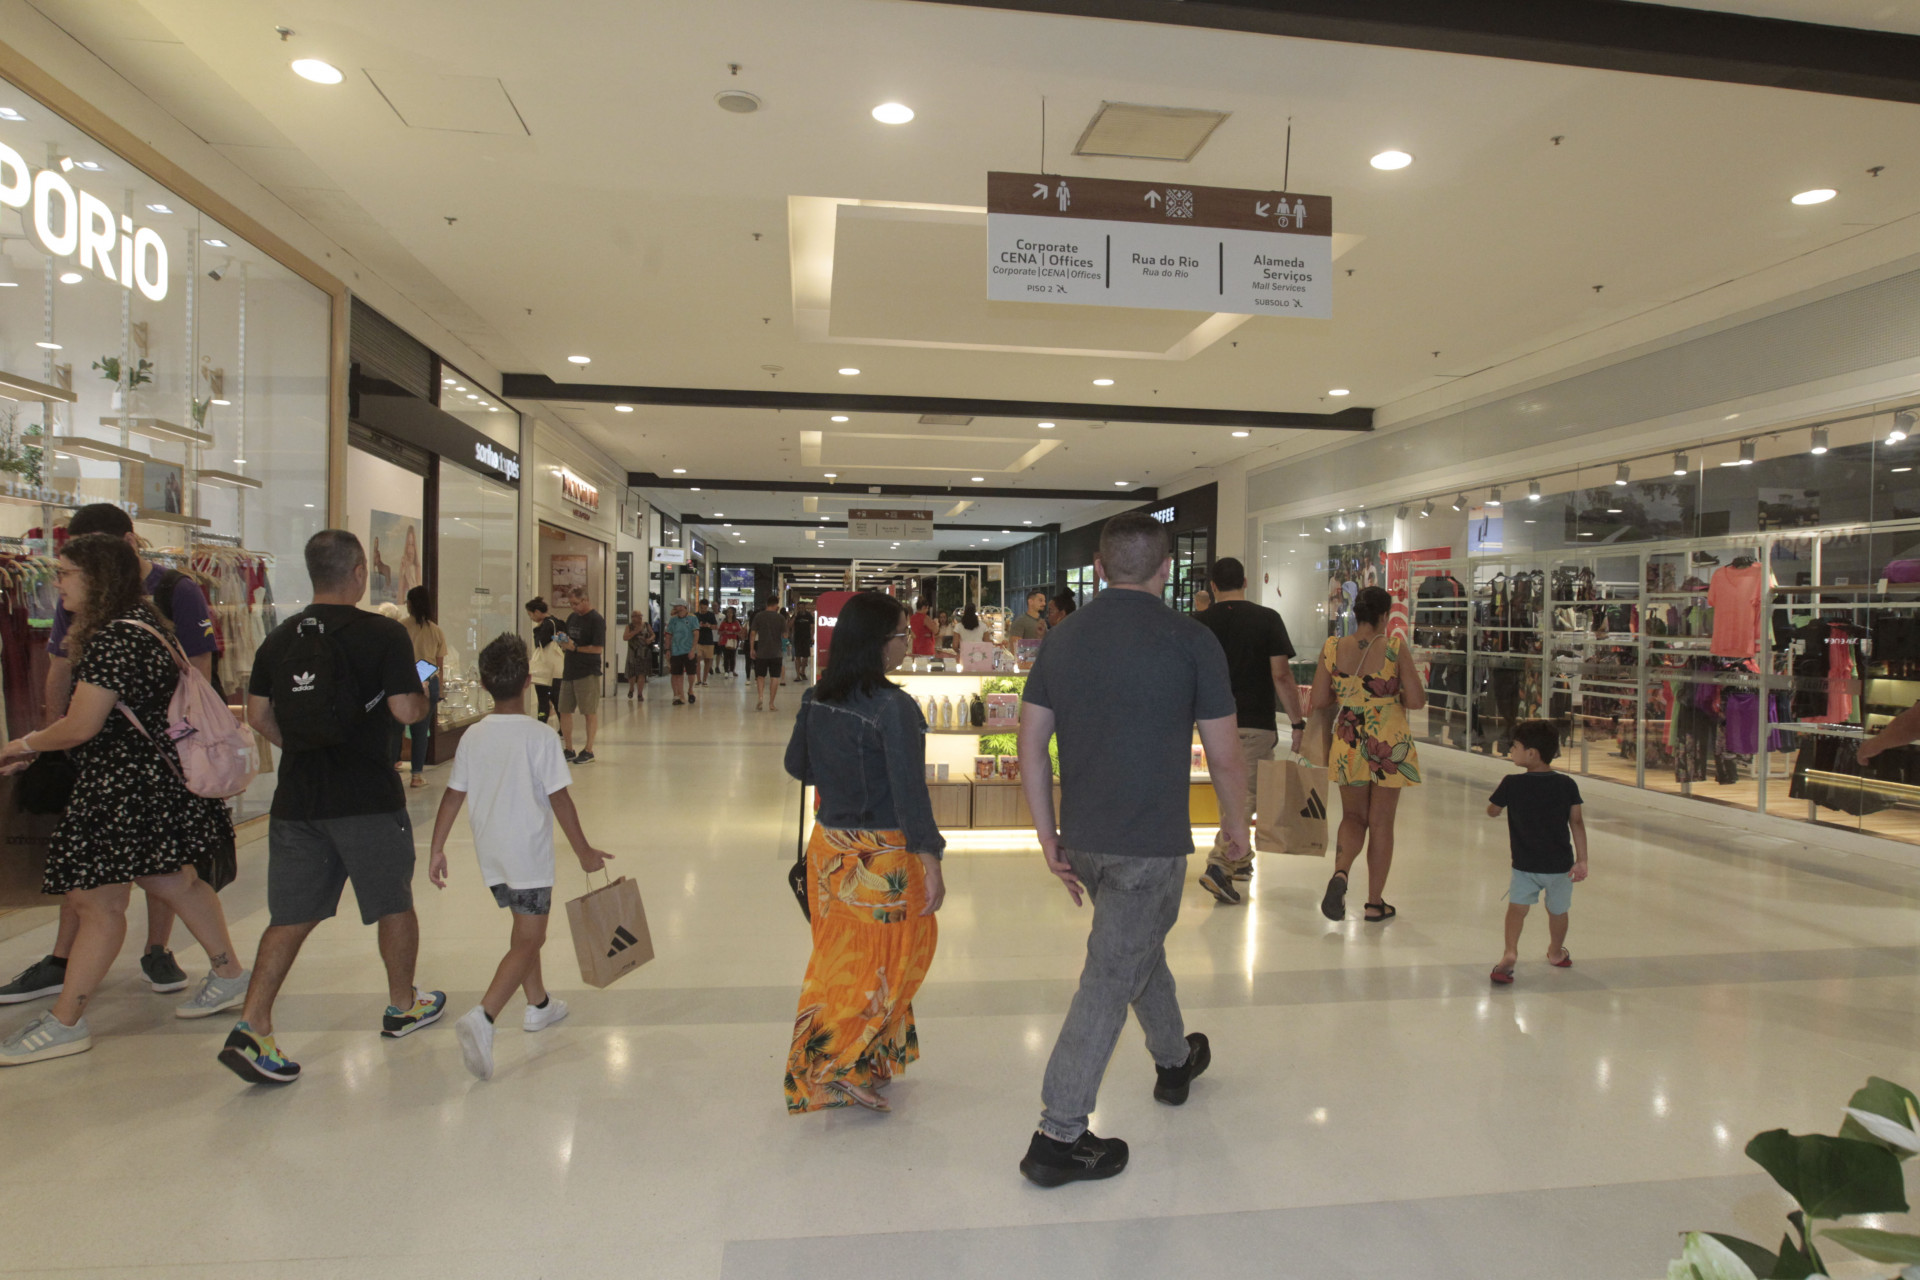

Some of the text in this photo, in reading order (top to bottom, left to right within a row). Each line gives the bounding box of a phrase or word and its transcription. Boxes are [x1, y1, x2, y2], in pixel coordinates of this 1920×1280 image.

[1016, 239, 1079, 253] Corporate
[1000, 251, 1094, 268] CENA Offices
[1132, 253, 1199, 268] Rua do Rio
[1253, 254, 1305, 268] Alameda
[992, 265, 1037, 276] Corporate
[1070, 270, 1102, 280] Offices
[1142, 267, 1189, 278] Rua do Rio
[1263, 268, 1313, 284] Serviços
[1027, 284, 1053, 293] PISO 2
[1252, 281, 1306, 293] Mall Services
[1254, 298, 1290, 307] SUBSOLO
[291, 684, 315, 692] adidas
